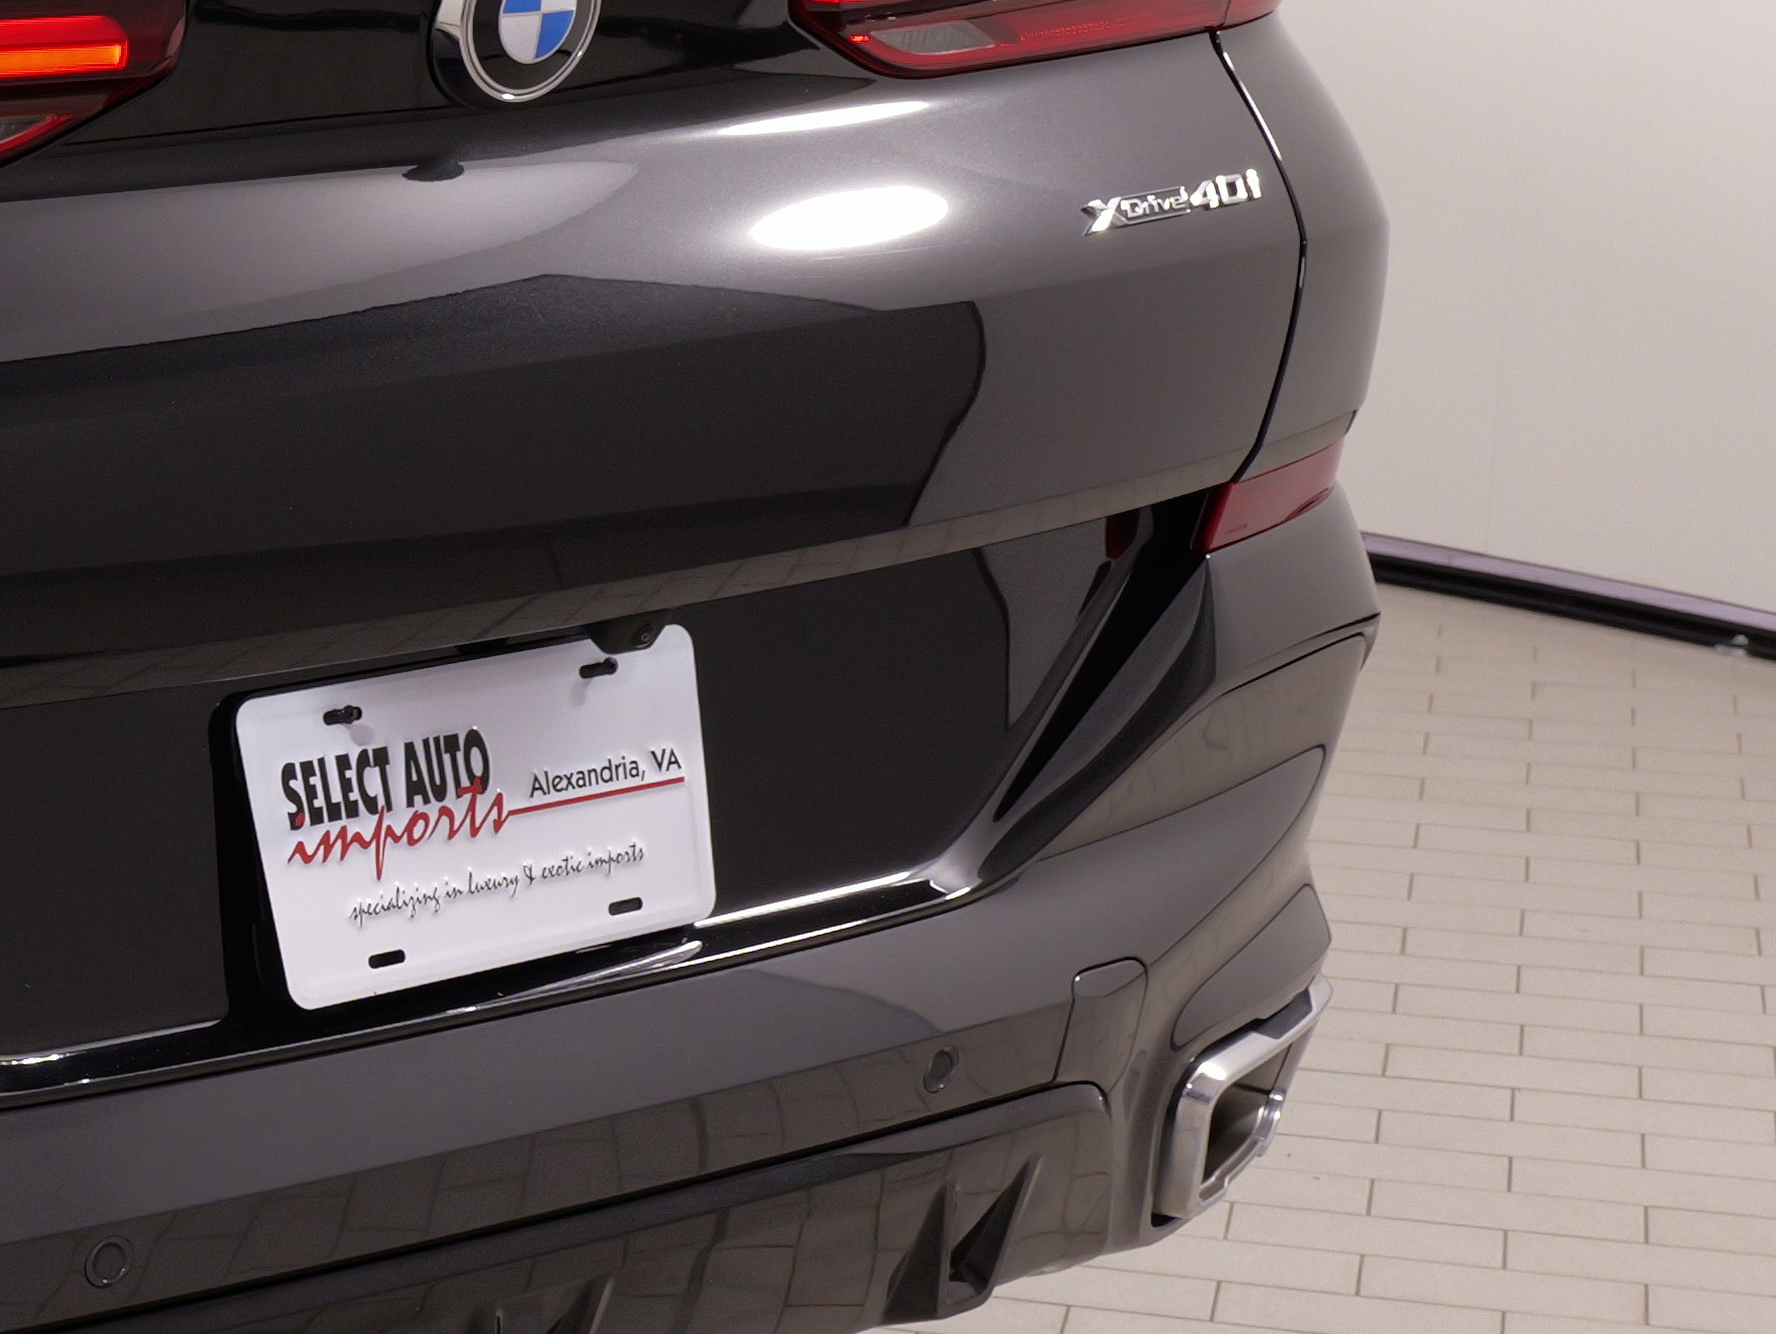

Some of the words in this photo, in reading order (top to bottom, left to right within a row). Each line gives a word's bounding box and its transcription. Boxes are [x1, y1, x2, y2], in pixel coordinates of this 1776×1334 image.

[280, 746, 391, 831] SELECT
[403, 728, 490, 808] AUTO
[529, 755, 646, 799] Alexandria,
[651, 748, 682, 772] VA
[287, 776, 510, 881] imports
[349, 886, 441, 927] specializing
[443, 880, 463, 899] in
[467, 870, 519, 900] luxury
[523, 863, 536, 885] &
[542, 855, 584, 880] exotic
[587, 841, 645, 875] imports
